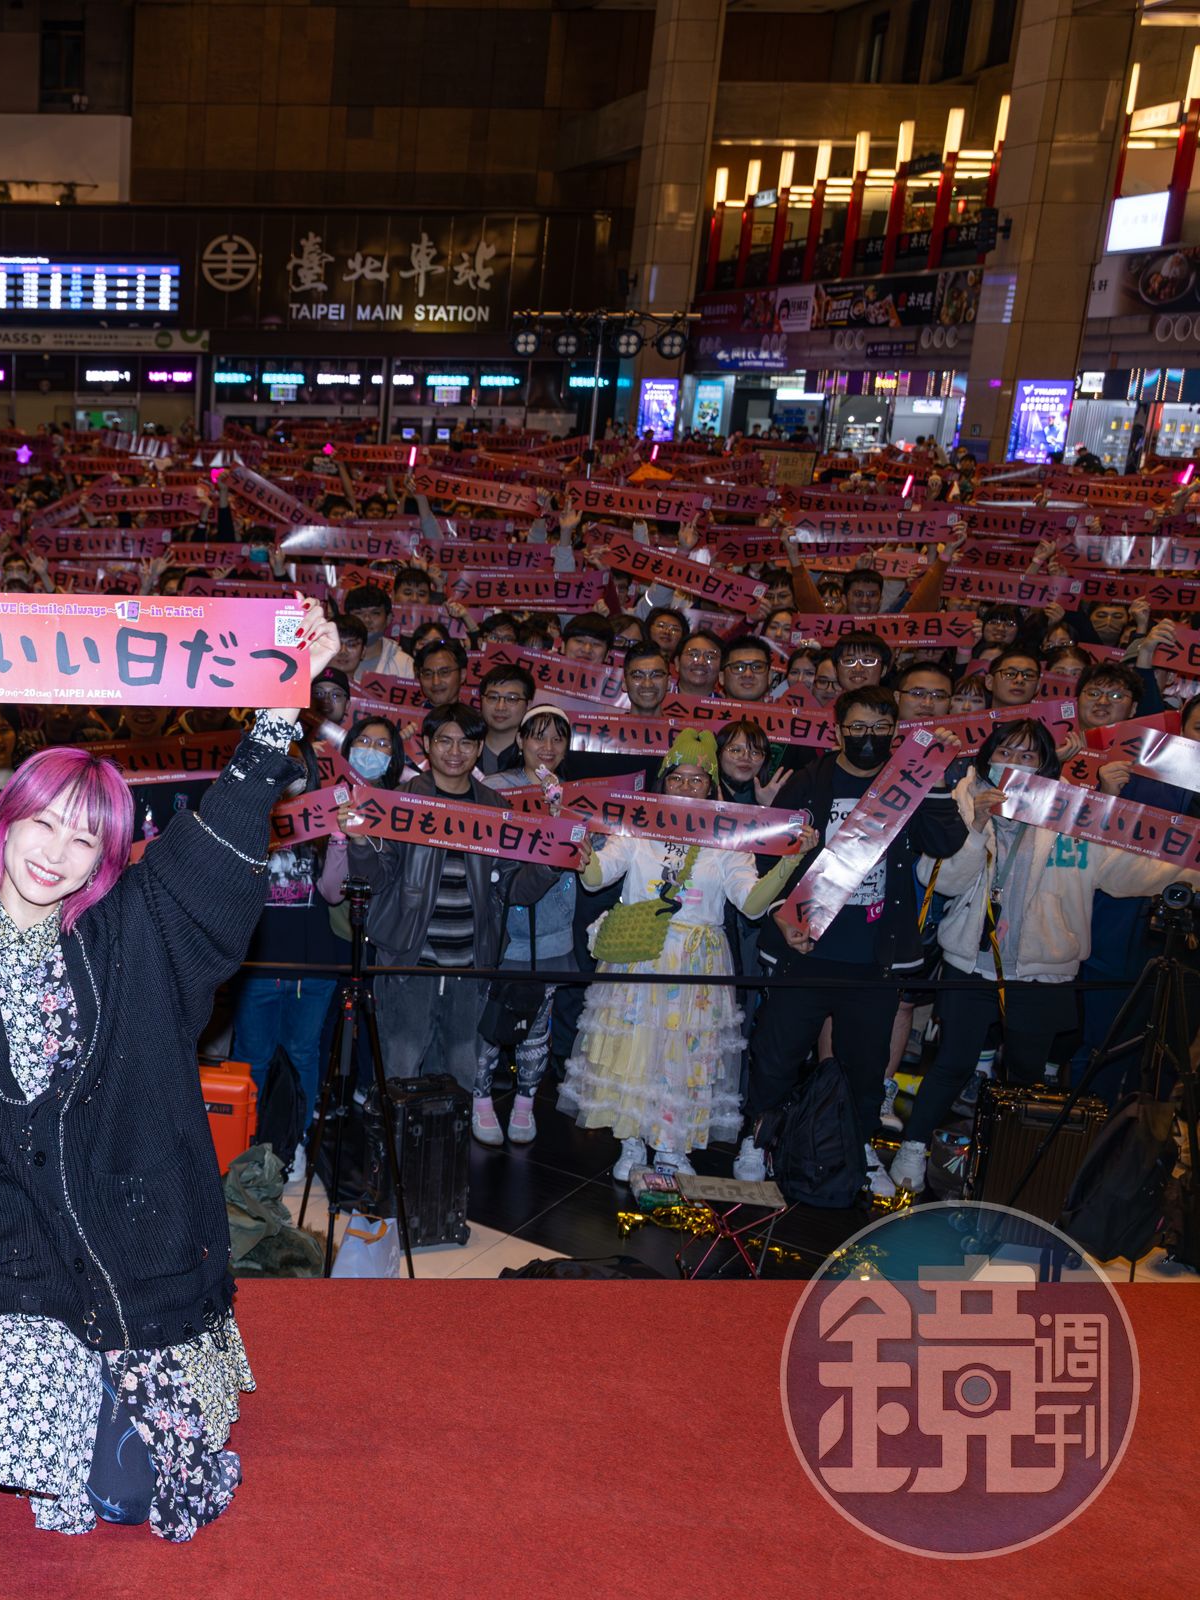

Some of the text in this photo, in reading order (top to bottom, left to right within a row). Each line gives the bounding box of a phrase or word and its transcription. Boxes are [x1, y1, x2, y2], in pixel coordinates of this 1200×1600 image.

[289, 303, 490, 322] TAIPEI MAIN STATION
[415, 475, 541, 511] 今日もいい日だっ
[610, 545, 757, 604] 今日もいい日だっ
[19, 603, 30, 614] is
[31, 603, 64, 615] Smile
[54, 688, 84, 698] TAIPEI
[86, 689, 122, 698] ARENA
[356, 798, 579, 857] 今日もいい日だっ
